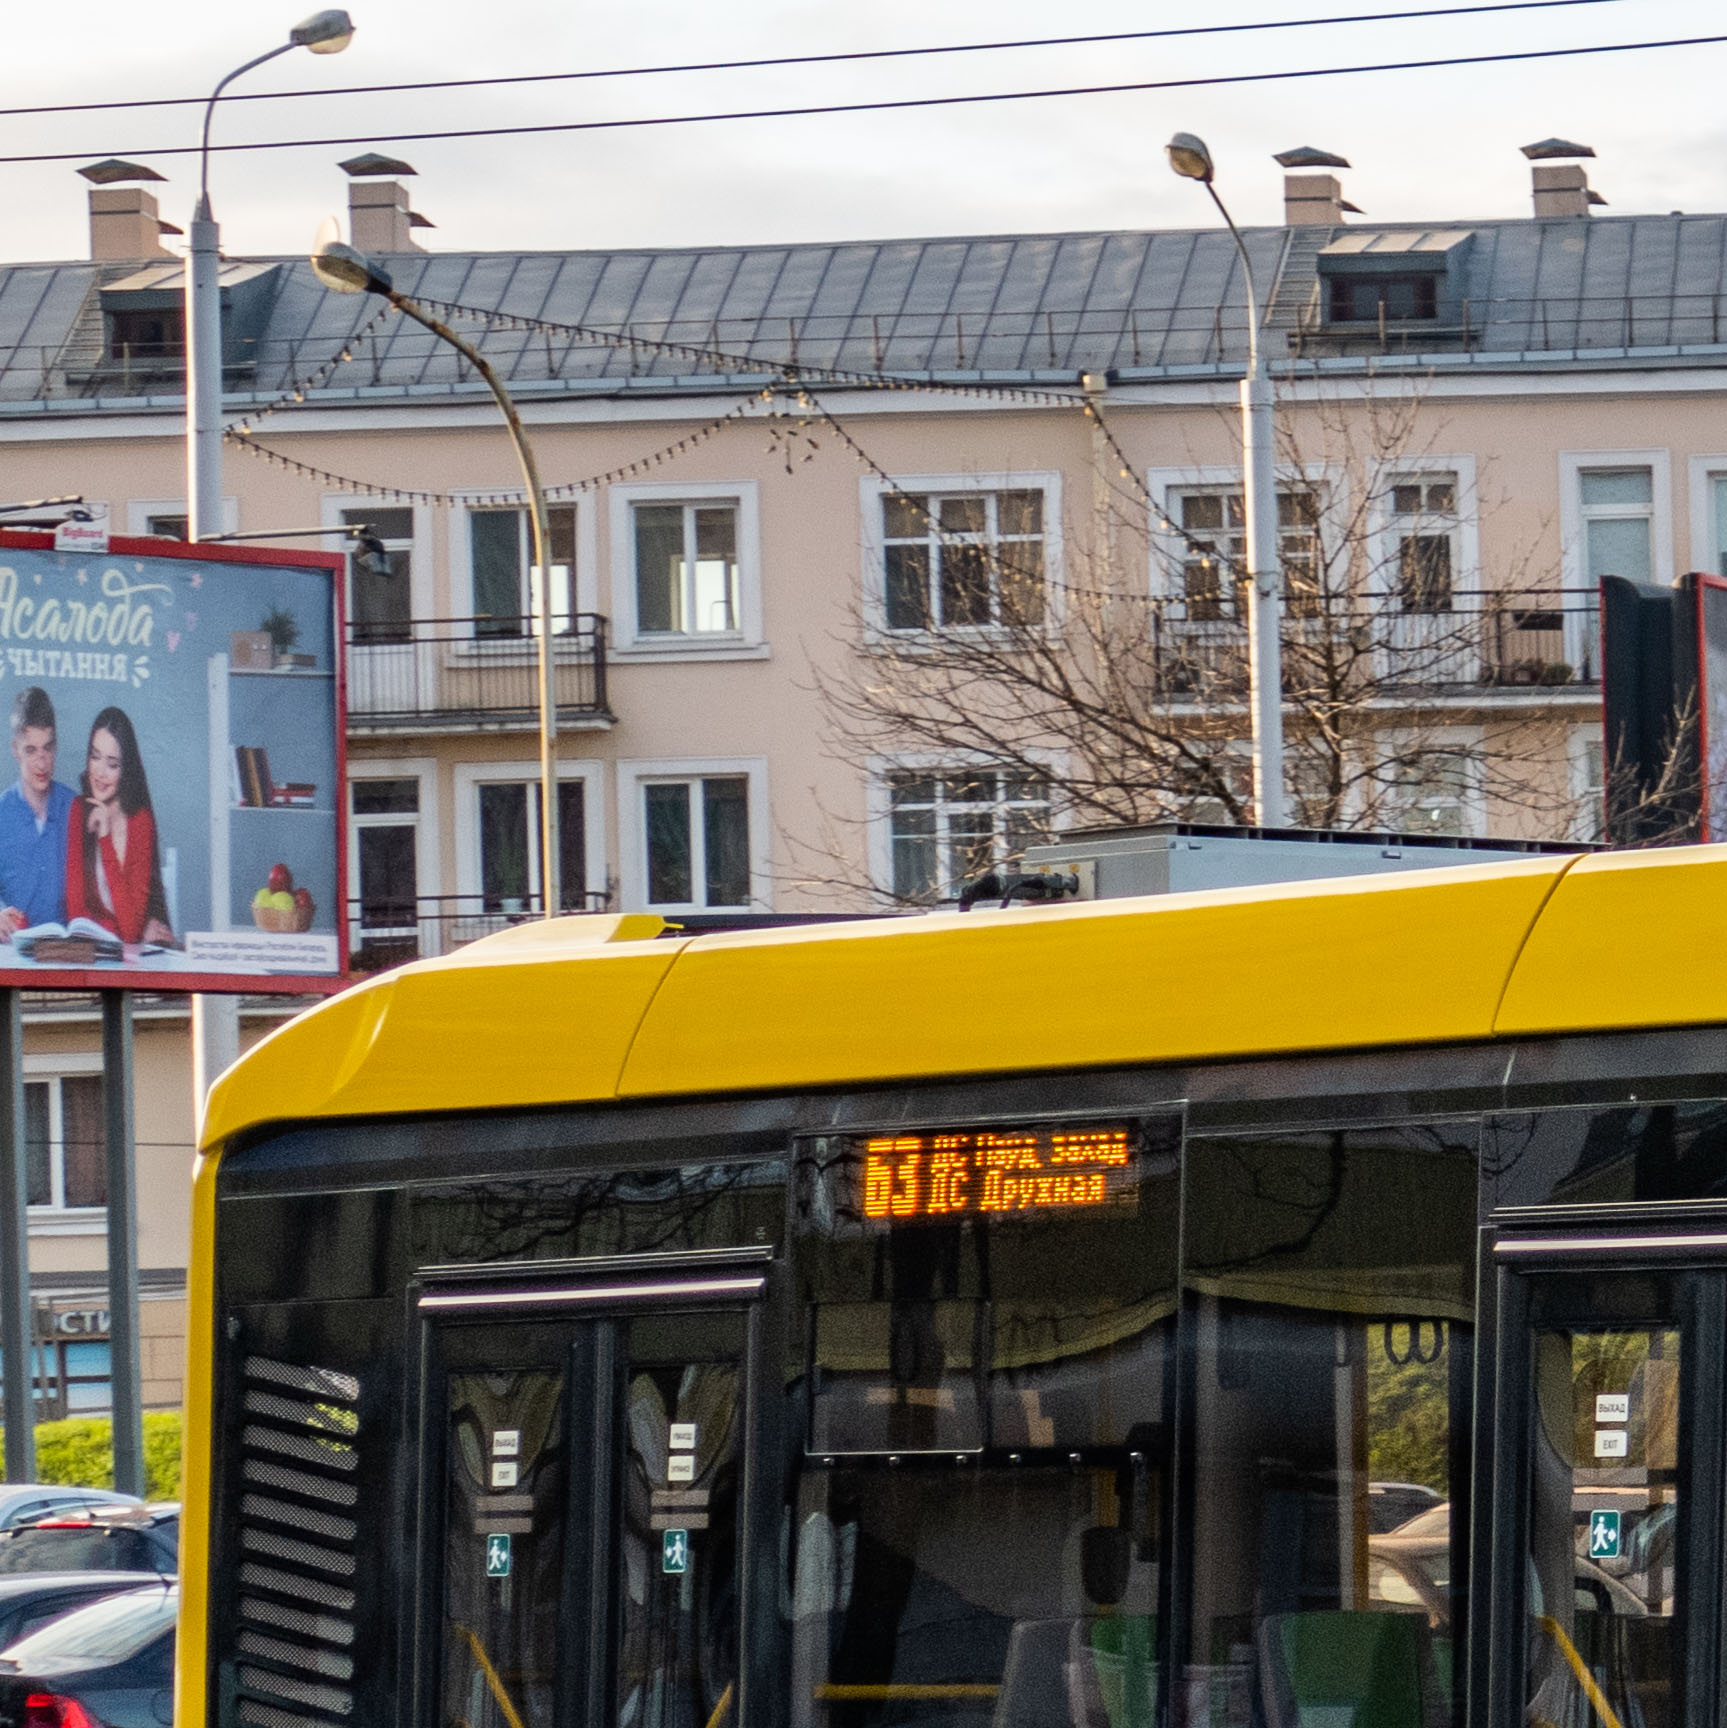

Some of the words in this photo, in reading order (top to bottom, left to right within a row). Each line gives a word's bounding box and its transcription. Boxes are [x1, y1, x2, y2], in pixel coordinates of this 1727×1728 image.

[7, 648, 128, 682] ЧЫТАННЯ
[866, 1136, 921, 1217] 63
[928, 1171, 968, 1213] ДС
[976, 1169, 1105, 1211] Дружная
